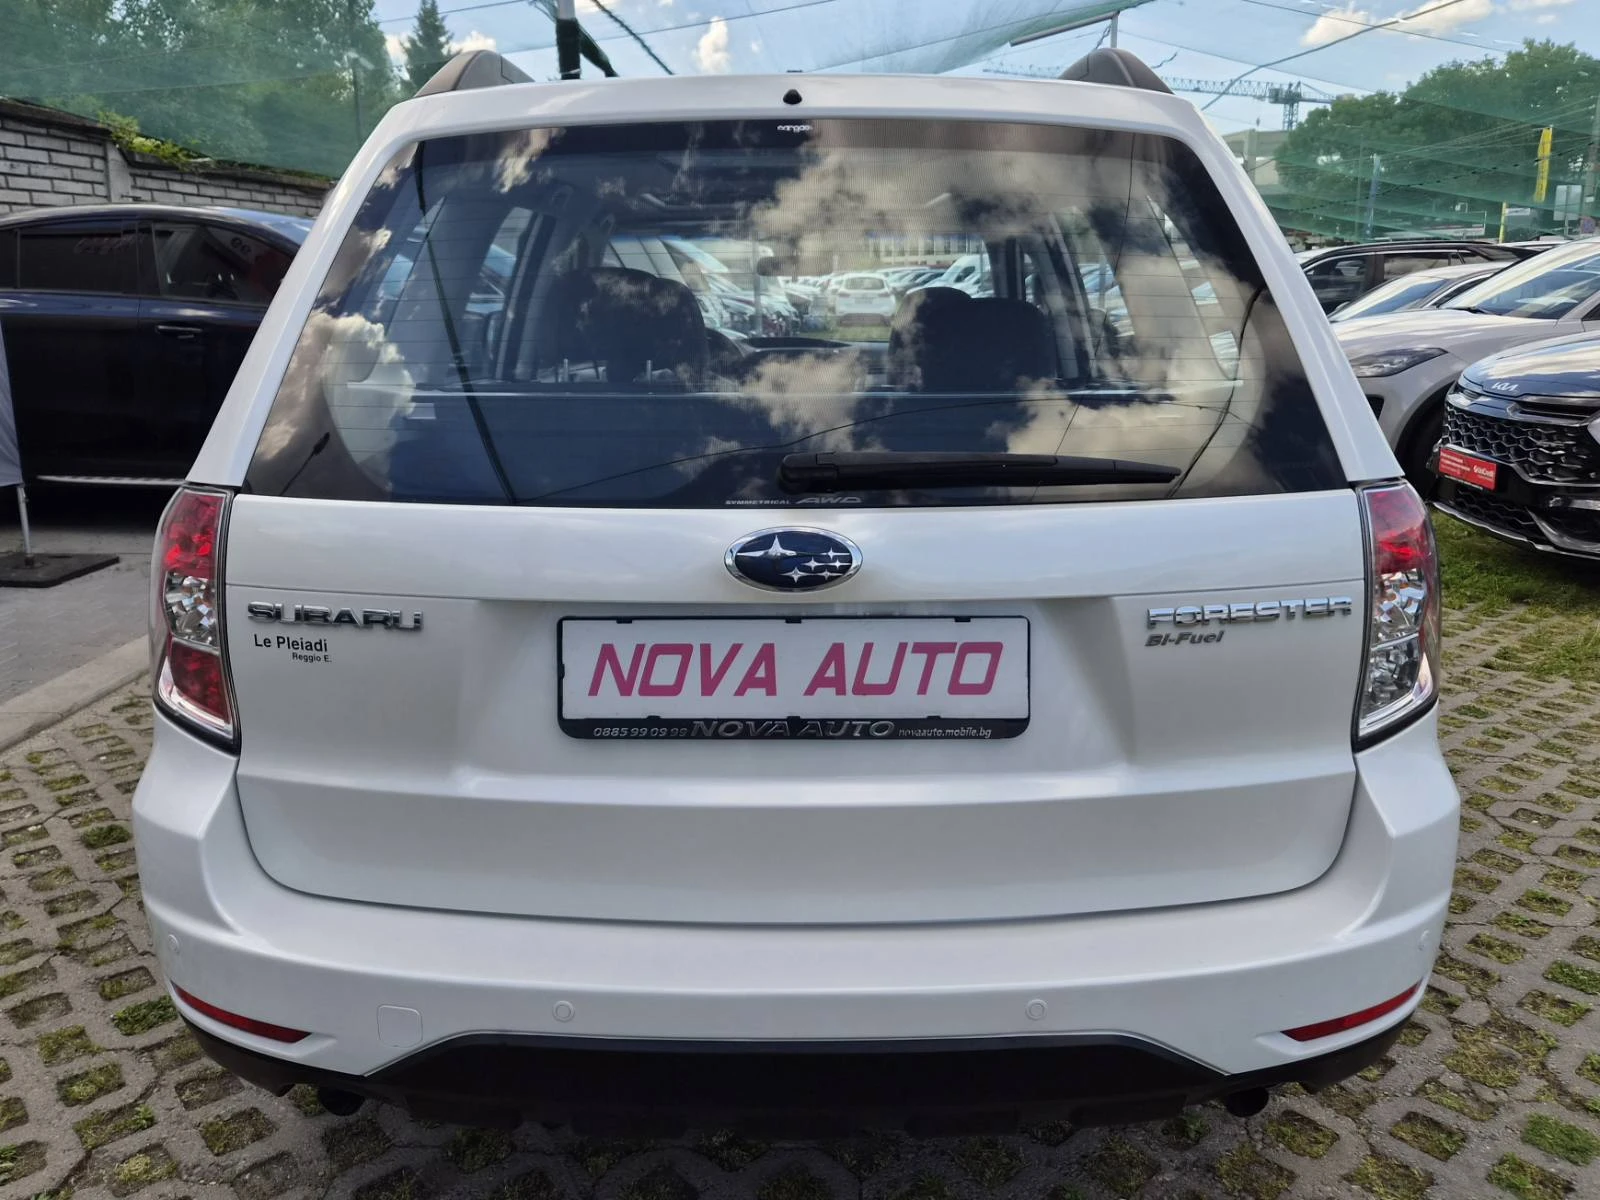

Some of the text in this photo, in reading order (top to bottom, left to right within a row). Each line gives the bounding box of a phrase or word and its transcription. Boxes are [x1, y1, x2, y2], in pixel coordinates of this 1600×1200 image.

[796, 496, 862, 504] AWD
[247, 601, 424, 631] SUBARU
[1147, 596, 1353, 629] FORESTER
[254, 633, 328, 652] Le Pleiadi
[292, 652, 333, 663] Reggio E.
[587, 641, 1004, 697] NOVA AUTO
[593, 727, 688, 737] 0885 99 09 99
[690, 720, 896, 737] NOVA AUTO
[898, 726, 992, 739] novaauto.mobile.bg
